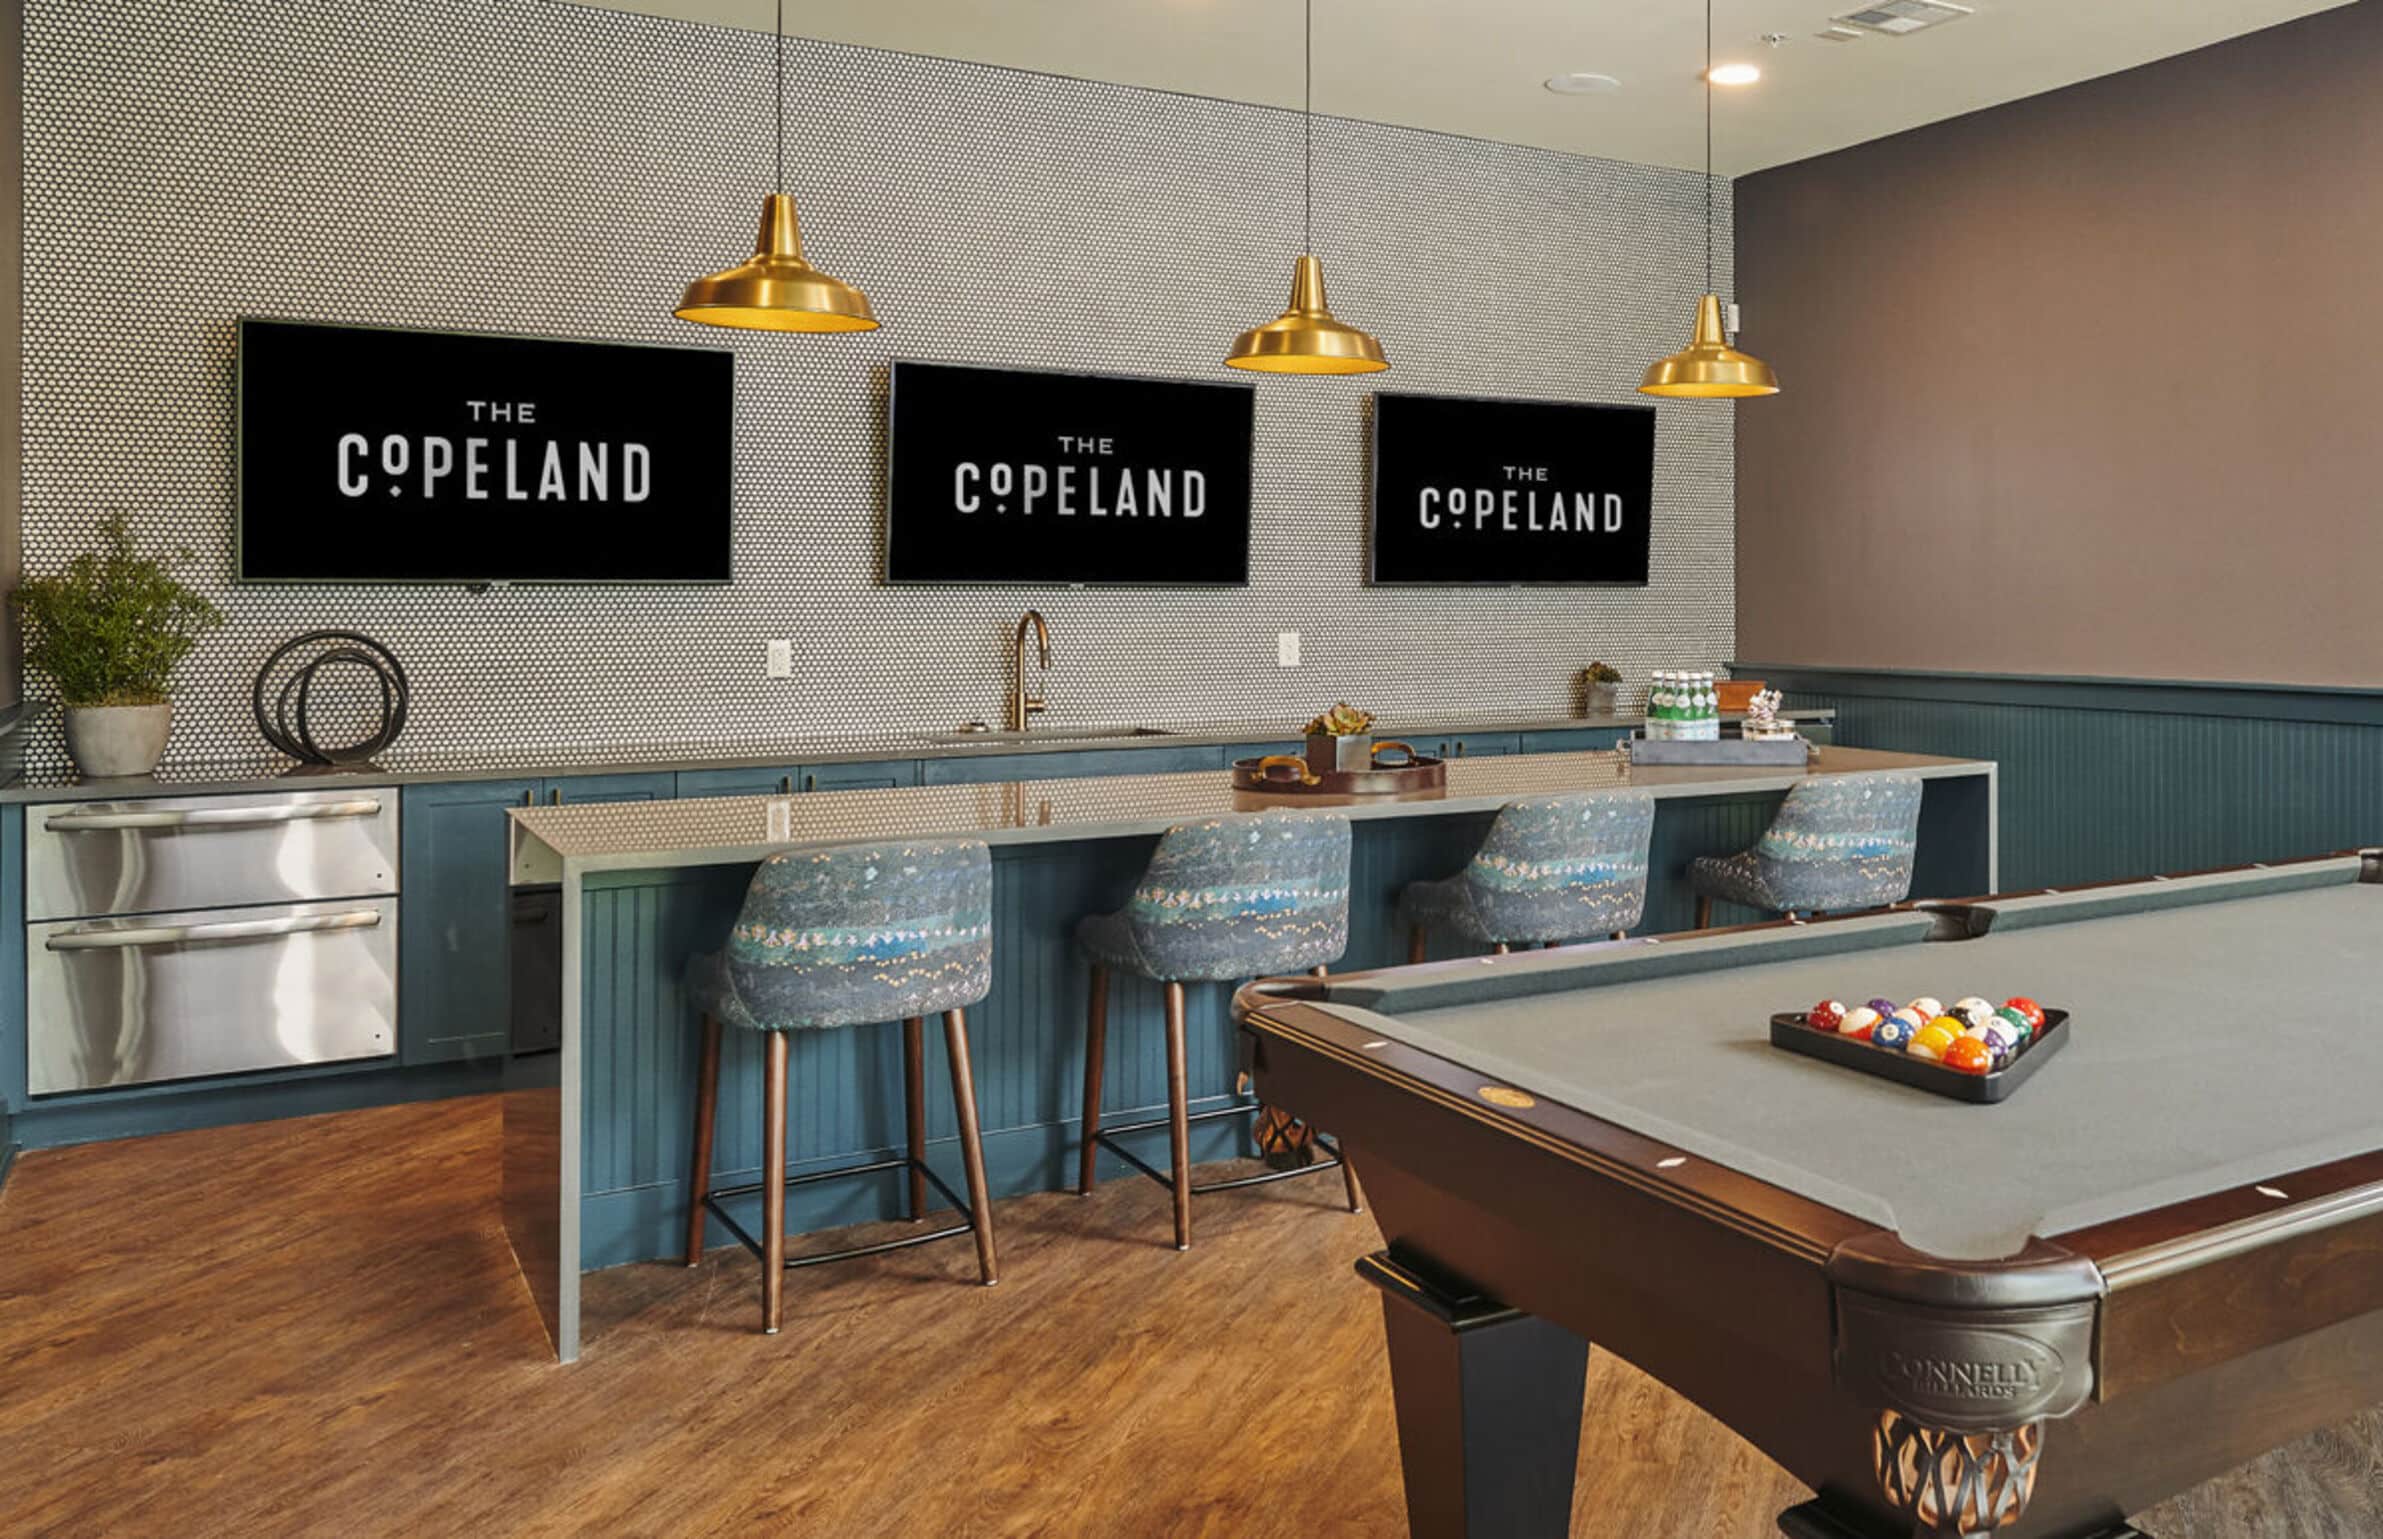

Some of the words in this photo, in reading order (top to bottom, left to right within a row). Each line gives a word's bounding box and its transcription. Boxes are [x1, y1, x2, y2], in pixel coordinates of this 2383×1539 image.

[467, 401, 535, 423] THE
[1058, 436, 1113, 454] THE
[338, 433, 650, 502] COPELAND
[1503, 466, 1547, 481] THE
[955, 462, 1205, 517] COPELAND
[1420, 487, 1622, 532] COPELAND
